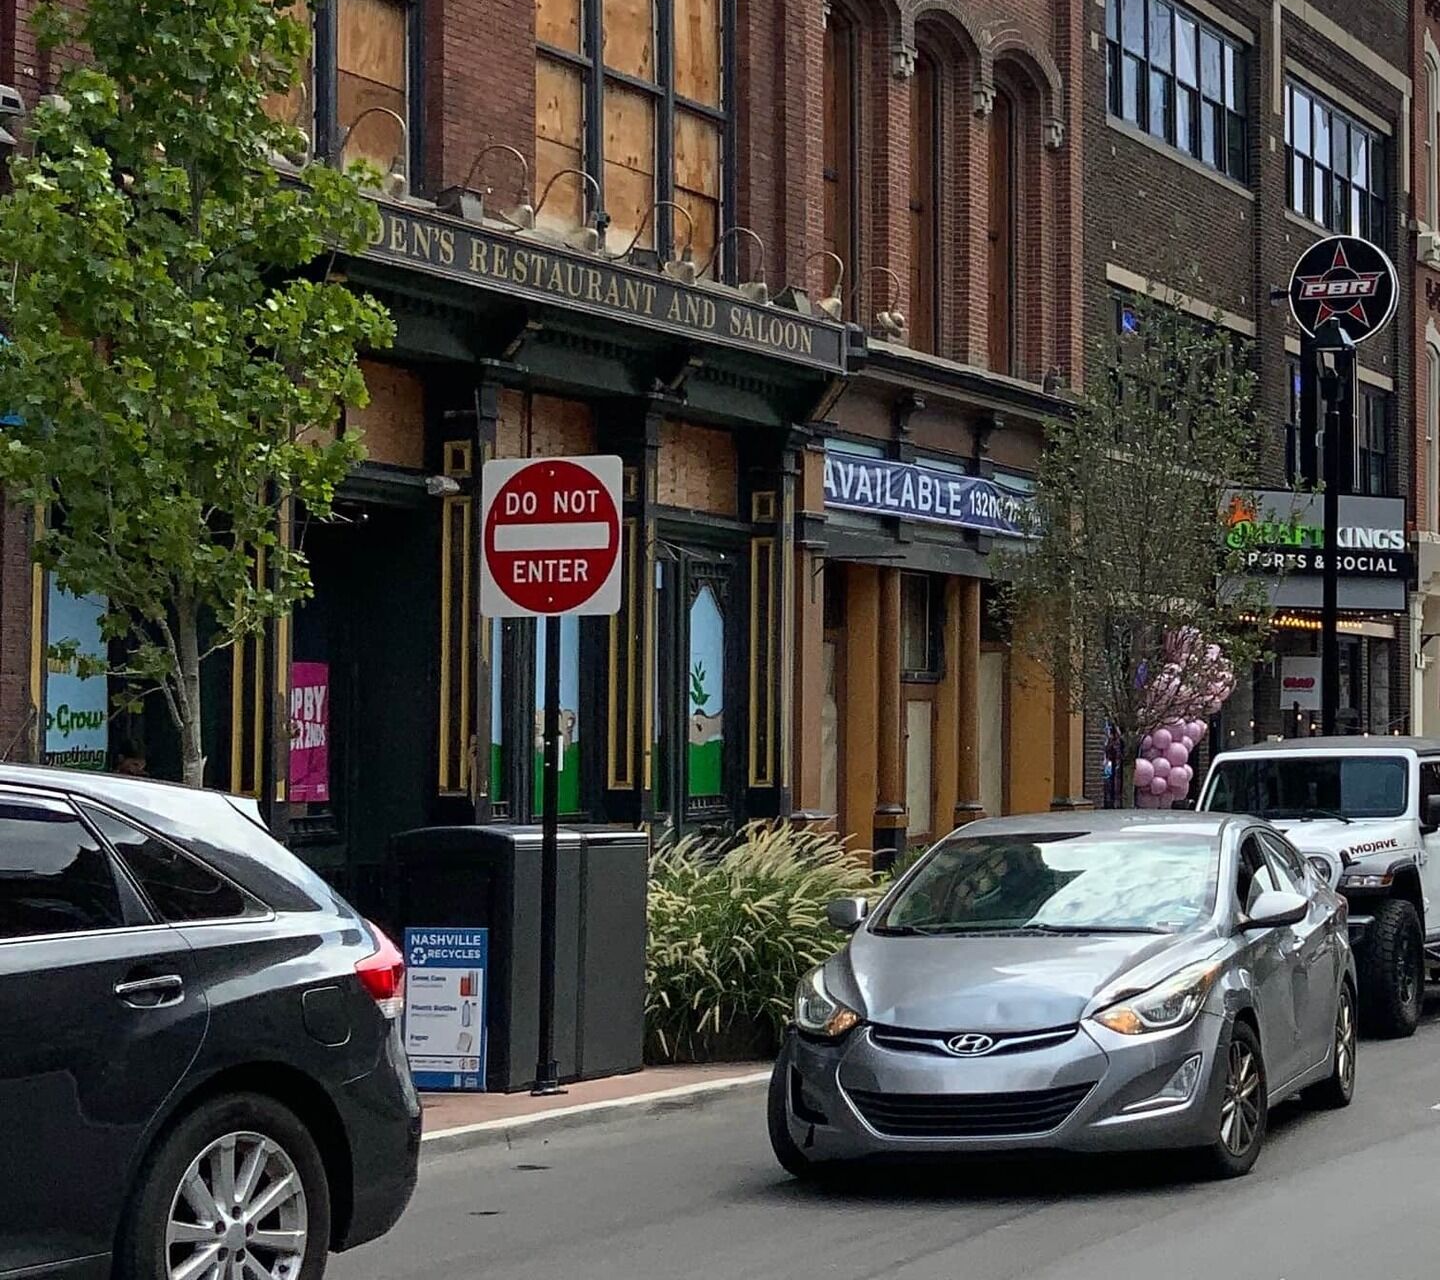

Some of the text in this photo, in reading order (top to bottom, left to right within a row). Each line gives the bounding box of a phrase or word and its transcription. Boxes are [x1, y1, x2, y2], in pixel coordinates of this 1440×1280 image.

[363, 216, 814, 354] DEN'S RESTAURANT AND SALOON
[1304, 281, 1371, 296] PBR
[824, 457, 962, 517] AVAILABLE
[505, 490, 600, 515] DO NOT
[1238, 552, 1307, 569] PORTS
[1314, 555, 1325, 569] &
[513, 559, 588, 583] ENTER
[57, 704, 104, 737] Grow
[1349, 838, 1398, 855] MOJAVE
[411, 934, 481, 947] NASHVILLE
[427, 948, 481, 960] RECYCLES
